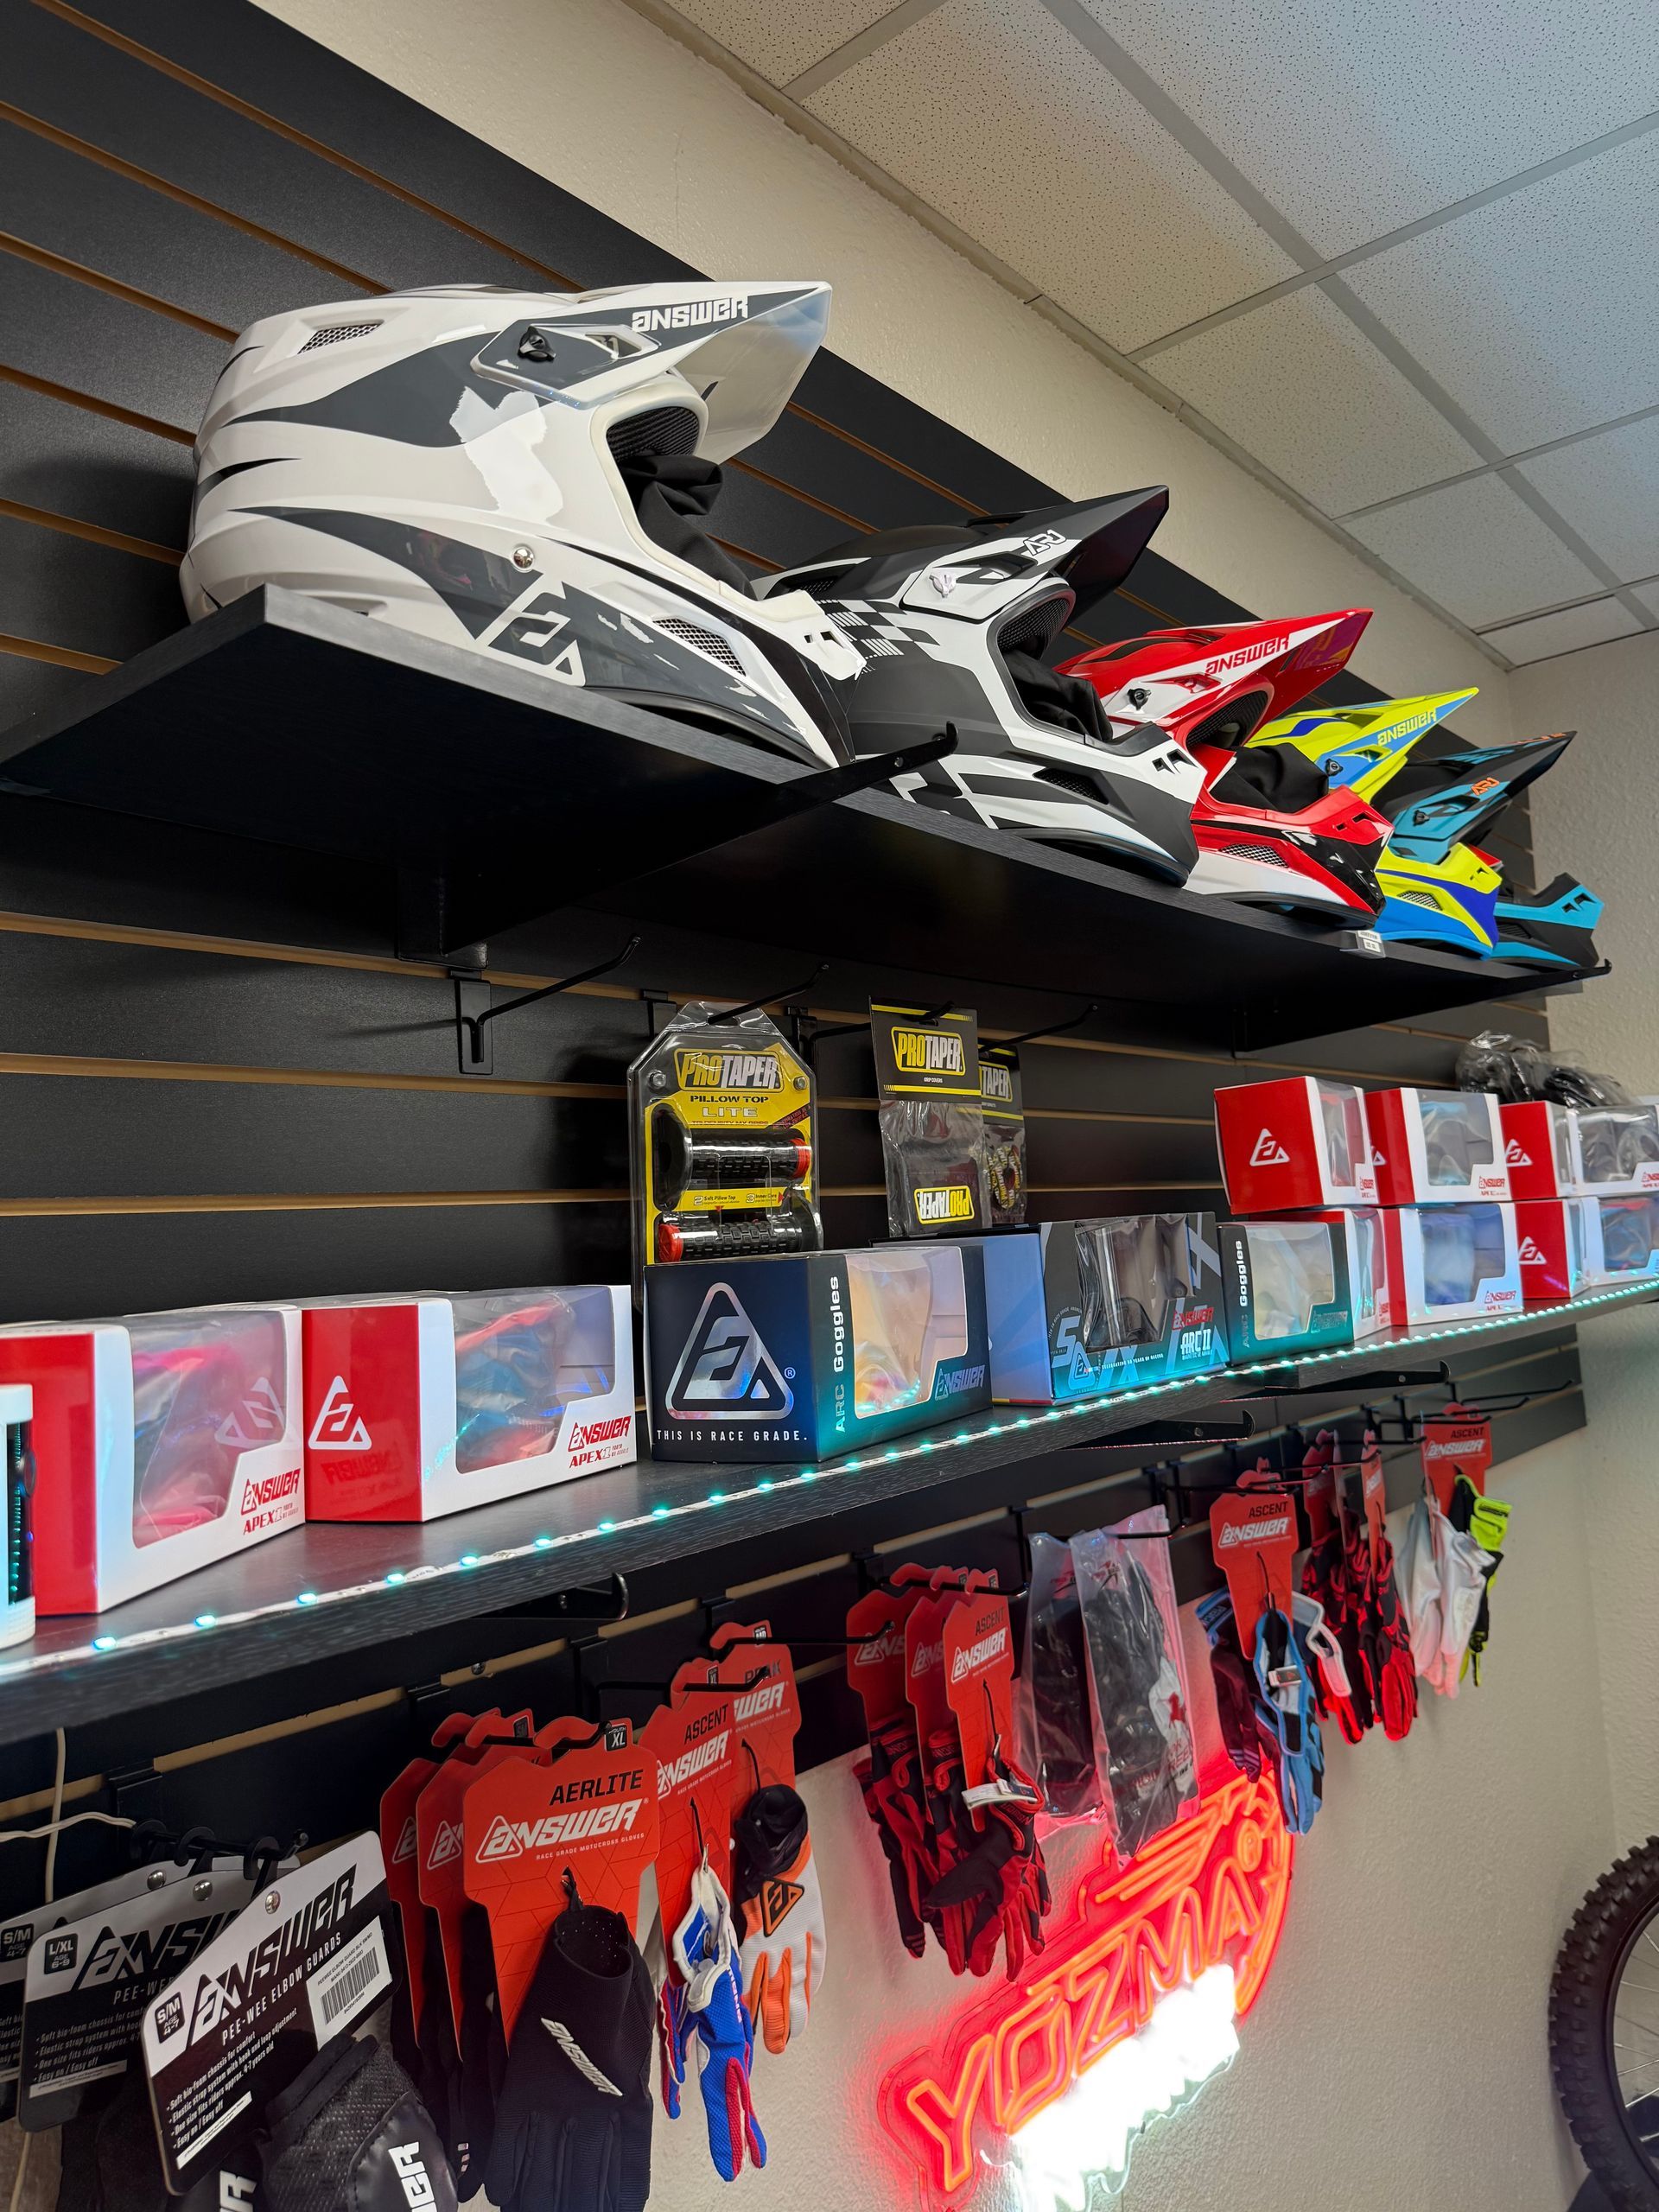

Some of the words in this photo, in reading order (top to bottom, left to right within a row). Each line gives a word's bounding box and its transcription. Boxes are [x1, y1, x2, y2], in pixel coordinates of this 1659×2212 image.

[632, 296, 748, 334] ANSWER
[1205, 636, 1289, 676] ANSWER
[1377, 710, 1437, 747] ANSWER
[980, 1065, 1010, 1099] TAPER
[702, 1107, 758, 1117] LITE
[694, 1196, 703, 1205] 2
[746, 1193, 755, 1204] 3
[1236, 1241, 1248, 1306] Goggles
[830, 1275, 845, 1373] Goggles
[935, 1364, 986, 1402] ANSWER
[835, 1383, 846, 1433] ARC
[568, 1415, 632, 1452] ANSWER
[657, 1430, 683, 1440] THIS
[690, 1430, 702, 1440] IS
[711, 1431, 744, 1441] RACE
[753, 1430, 808, 1440] GRADE.
[1426, 1439, 1485, 1460] ANSWER
[1450, 1427, 1484, 1440] ASCENT
[241, 1468, 301, 1516] ANSWER
[1249, 1502, 1288, 1518] ASCENT
[1218, 1517, 1289, 1548] ANSWER
[976, 1606, 1004, 1636] ASCENT
[950, 1628, 1007, 1683] ANSWER
[611, 1732, 626, 1748] XL
[684, 1703, 729, 1745] ASCENT
[549, 1770, 644, 1806] AERLITE
[475, 1797, 643, 1864] ANSWER
[536, 1852, 553, 1860] RACE
[556, 1847, 577, 1857] GRADE
[621, 1833, 645, 1845] GLOVES
[3, 1928, 31, 1944] S/M
[49, 1939, 73, 1955] L/XL
[51, 1959, 70, 1969] 6-9
[222, 1996, 268, 2046] PEE-WEE
[271, 1965, 303, 2003] ELBOW
[307, 1932, 341, 1972] GUARDS
[157, 1997, 181, 2024] S/M
[163, 2015, 178, 2027] AGE
[163, 2020, 180, 2035] 4-7
[906, 1859, 1262, 2193] YOZMA
[170, 2094, 183, 2110] Soft
[208, 2057, 227, 2078] chassis
[227, 2049, 236, 2059] for
[236, 2031, 256, 2053] comfort
[173, 2098, 192, 2124] Elastic
[193, 2088, 207, 2110] strap
[207, 2073, 226, 2095] system
[226, 2061, 238, 2077] with
[238, 2051, 251, 2067] hook
[251, 2043, 260, 2056] and
[260, 2031, 271, 2048] loop
[271, 2007, 297, 2036] adjustment
[175, 2123, 186, 2137] One
[186, 2110, 198, 2126] size
[198, 2102, 208, 2118] fits
[208, 2088, 225, 2109] riders
[252, 2051, 266, 2069] years
[266, 2041, 275, 2054] old
[177, 2132, 191, 2149] Easy
[190, 2122, 199, 2133] on
[202, 2109, 215, 2126] Easy
[215, 2100, 225, 2115] off
